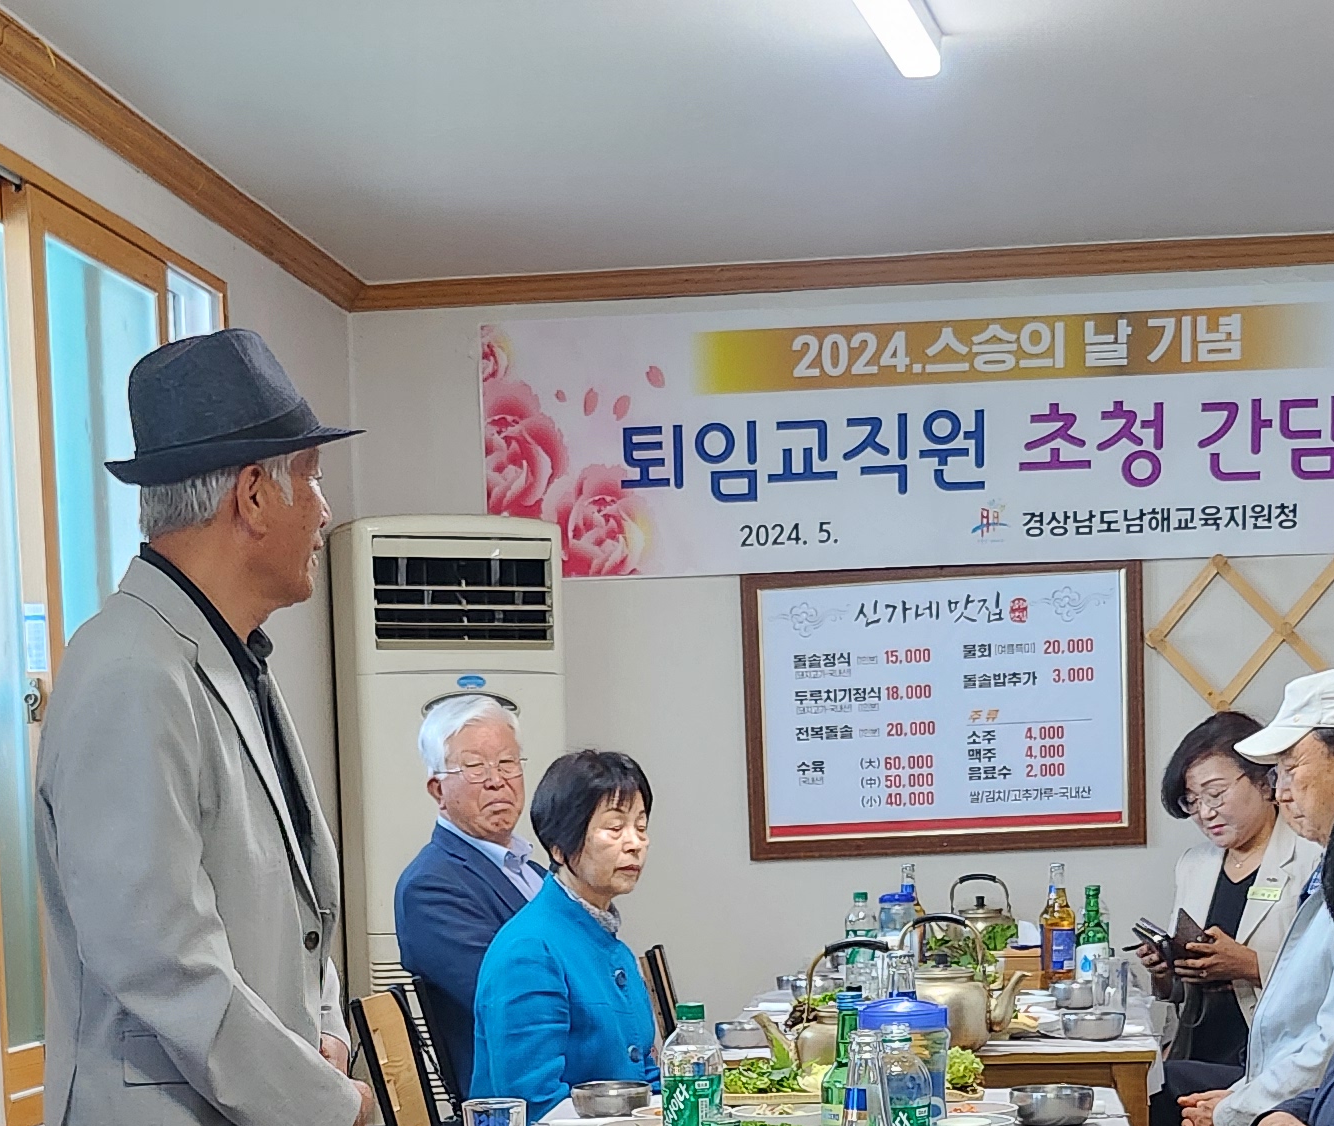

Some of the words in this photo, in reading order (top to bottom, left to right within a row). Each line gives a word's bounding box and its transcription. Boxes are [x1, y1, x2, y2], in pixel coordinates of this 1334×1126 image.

[792, 321, 1064, 378] 2024.스승의
[1085, 317, 1132, 368] 날
[1147, 313, 1242, 364] 기념
[620, 408, 987, 503] 퇴임교직원
[1018, 400, 1165, 488] 초청
[1021, 502, 1299, 538] 경상남도남해교육지원청
[739, 524, 809, 547] 2024.
[817, 521, 840, 545] 5.
[884, 648, 931, 665] 15,000
[963, 643, 992, 660] 물회
[1043, 638, 1094, 655] 20,000
[1052, 667, 1094, 683] 3,000
[794, 686, 882, 705] 두루치기정식
[885, 684, 932, 701] 18,000
[886, 720, 936, 737] 20,000
[967, 730, 997, 745] 소주
[1024, 725, 1065, 741] 4,000
[967, 748, 997, 763] 맥주
[1024, 744, 1065, 760] 4,000
[796, 760, 826, 776] 수육
[859, 757, 881, 770] (大)
[884, 755, 934, 771] 60,000
[967, 765, 1013, 781] 음료수
[1025, 762, 1065, 778] 2,000
[860, 776, 881, 789] (中)
[884, 772, 934, 789] 50,000
[861, 795, 882, 808] (小)
[885, 790, 935, 808] 40,000
